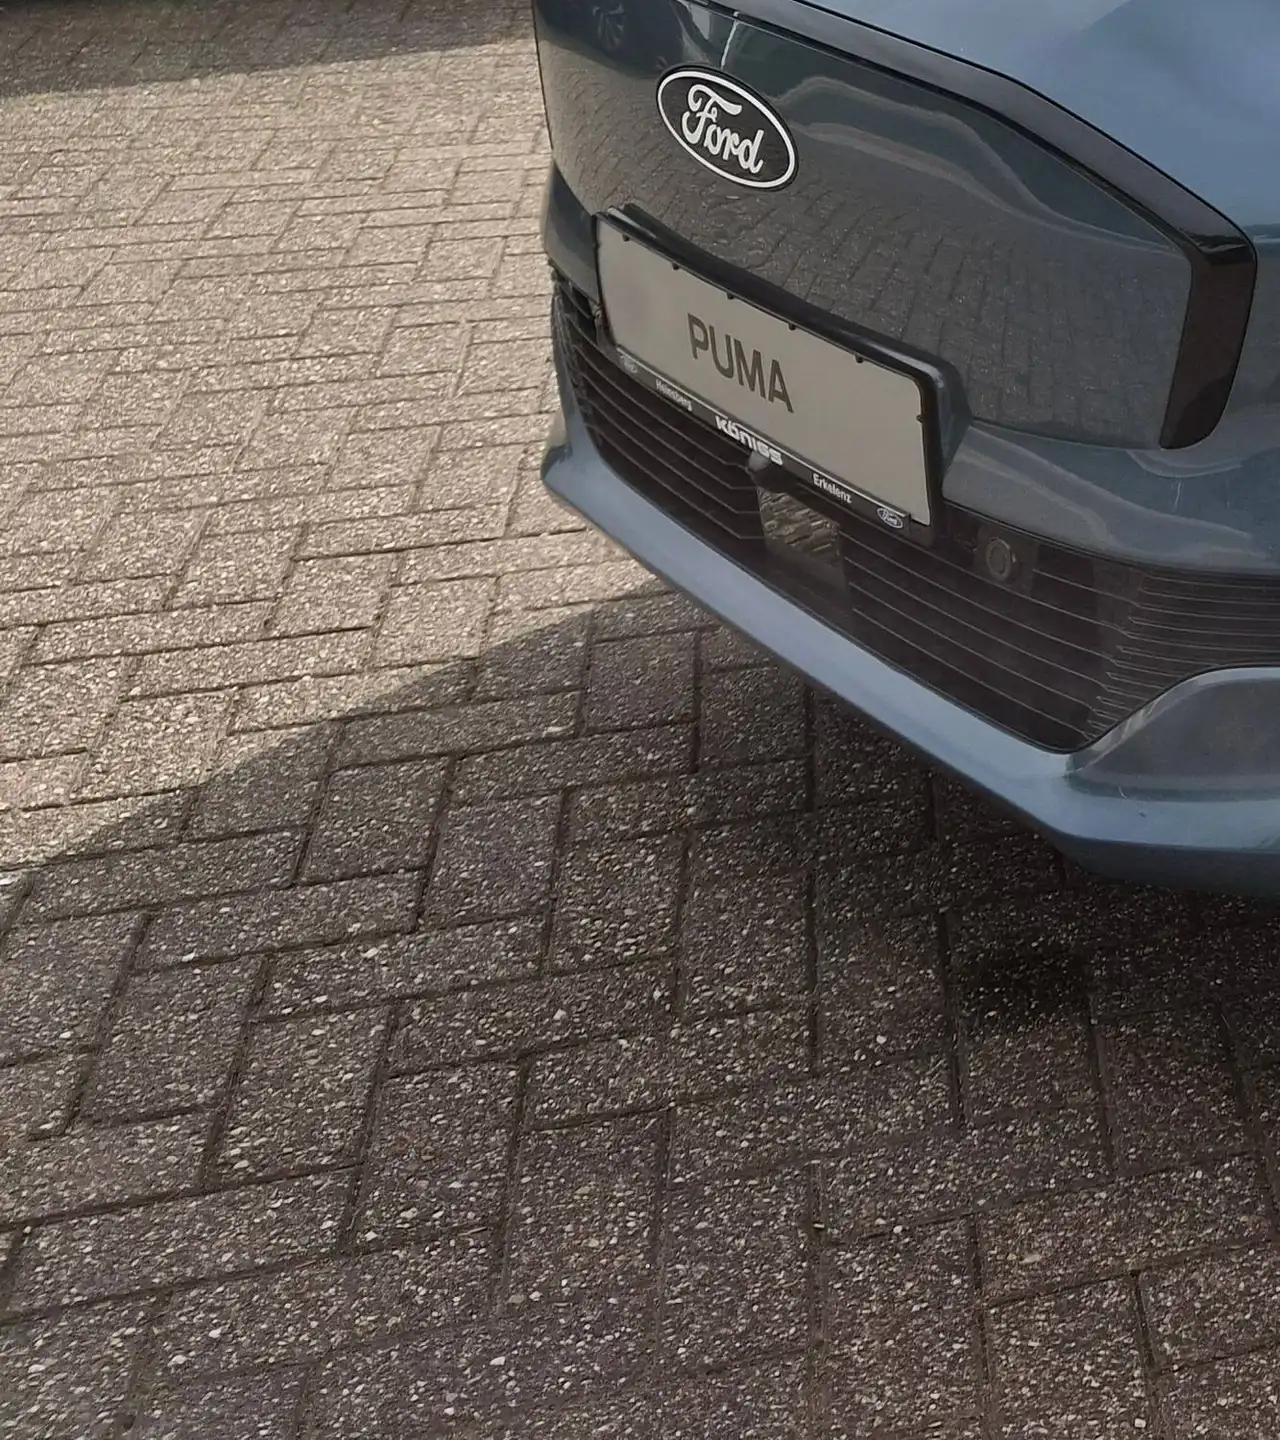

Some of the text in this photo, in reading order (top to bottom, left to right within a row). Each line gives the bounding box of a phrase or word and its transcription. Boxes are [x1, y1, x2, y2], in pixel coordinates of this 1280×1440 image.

[682, 83, 765, 174] Ford
[687, 312, 795, 414] PUMA
[812, 472, 852, 504] Erkelenz
